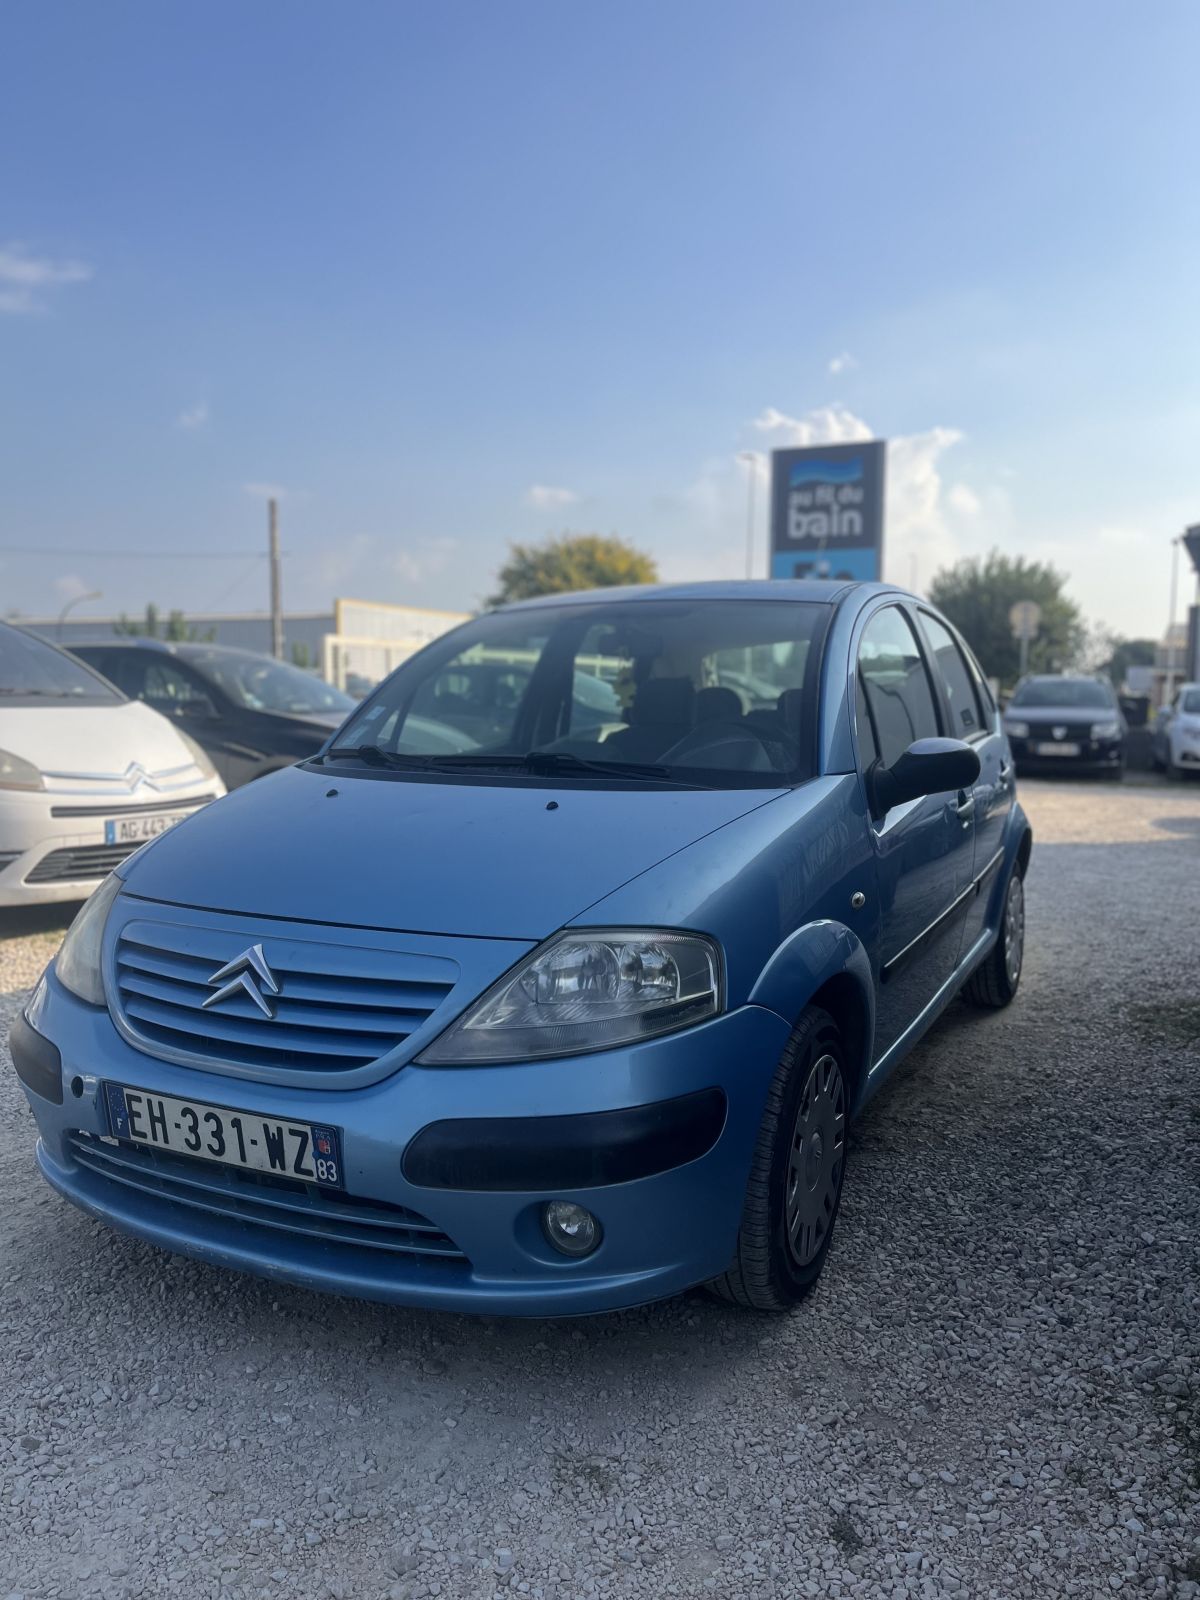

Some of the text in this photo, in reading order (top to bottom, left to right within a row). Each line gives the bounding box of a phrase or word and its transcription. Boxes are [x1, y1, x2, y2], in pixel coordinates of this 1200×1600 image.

[788, 504, 863, 539] bain
[117, 1117, 123, 1129] F
[125, 1093, 314, 1177] EH-331-WZ
[317, 1158, 337, 1182] 83
